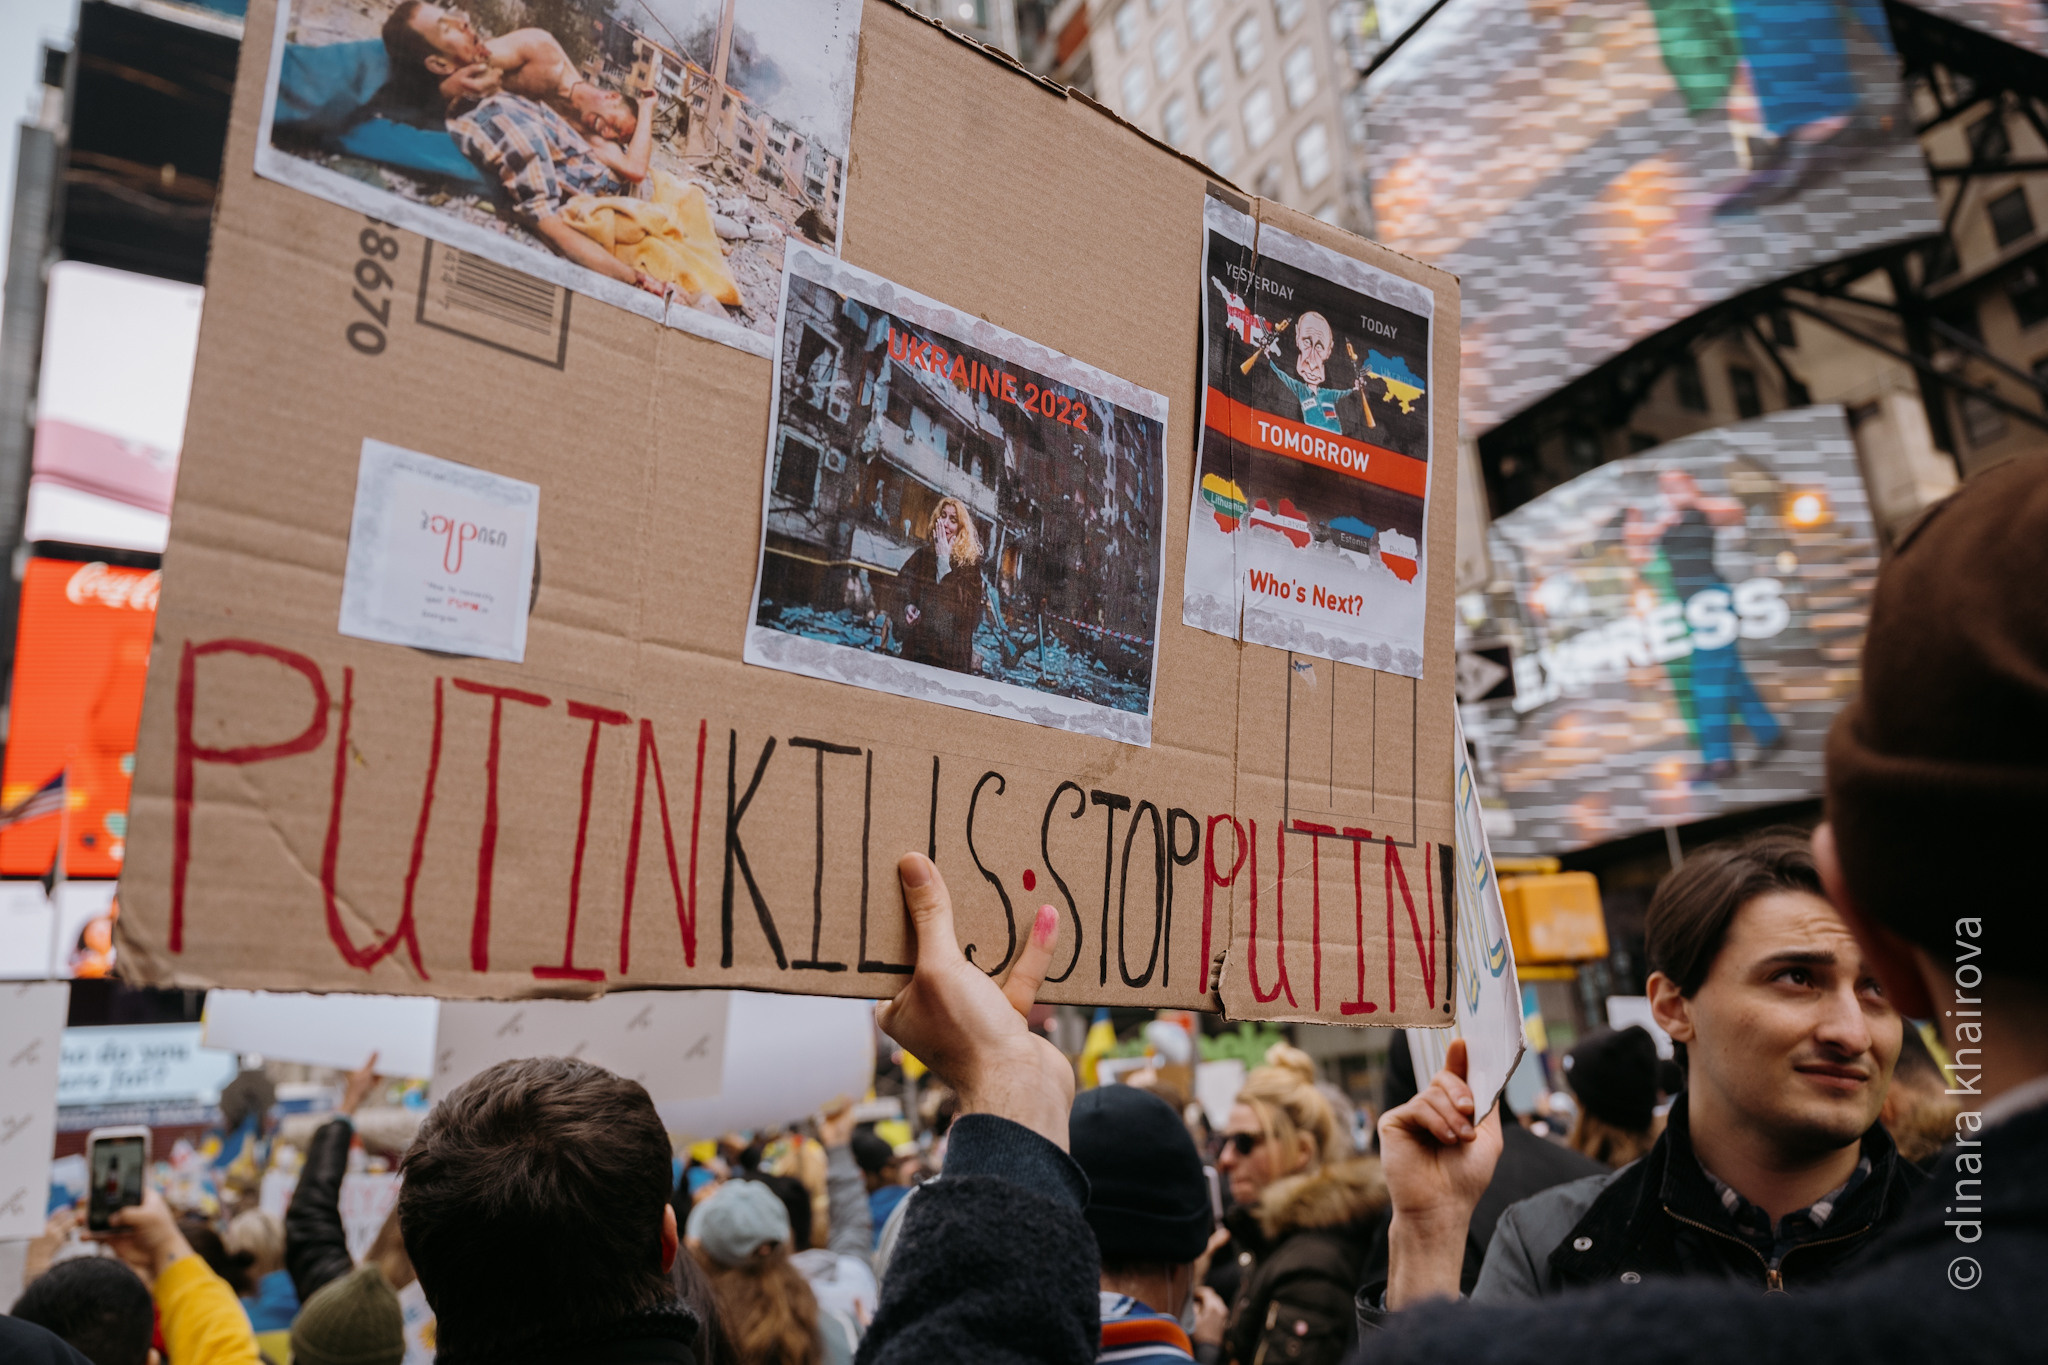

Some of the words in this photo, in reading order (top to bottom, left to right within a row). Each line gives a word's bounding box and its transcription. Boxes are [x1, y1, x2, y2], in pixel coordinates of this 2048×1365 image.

[345, 215, 399, 357] 8670
[1225, 261, 1294, 300] YESTERDAY
[1360, 315, 1398, 339] TODAY
[887, 327, 1017, 405] UKRAINE
[1023, 382, 1090, 432] 2022
[1258, 420, 1370, 473] TOMORROW
[1210, 492, 1244, 513] Lithuania
[1282, 519, 1307, 531] Latvia
[1340, 532, 1368, 548] Estonia
[1249, 568, 1306, 603] Who's
[1312, 584, 1364, 616] Next?
[169, 637, 708, 981] PUTIN
[1040, 780, 1201, 989] STOP
[1199, 813, 1457, 1015] PUTIN!
